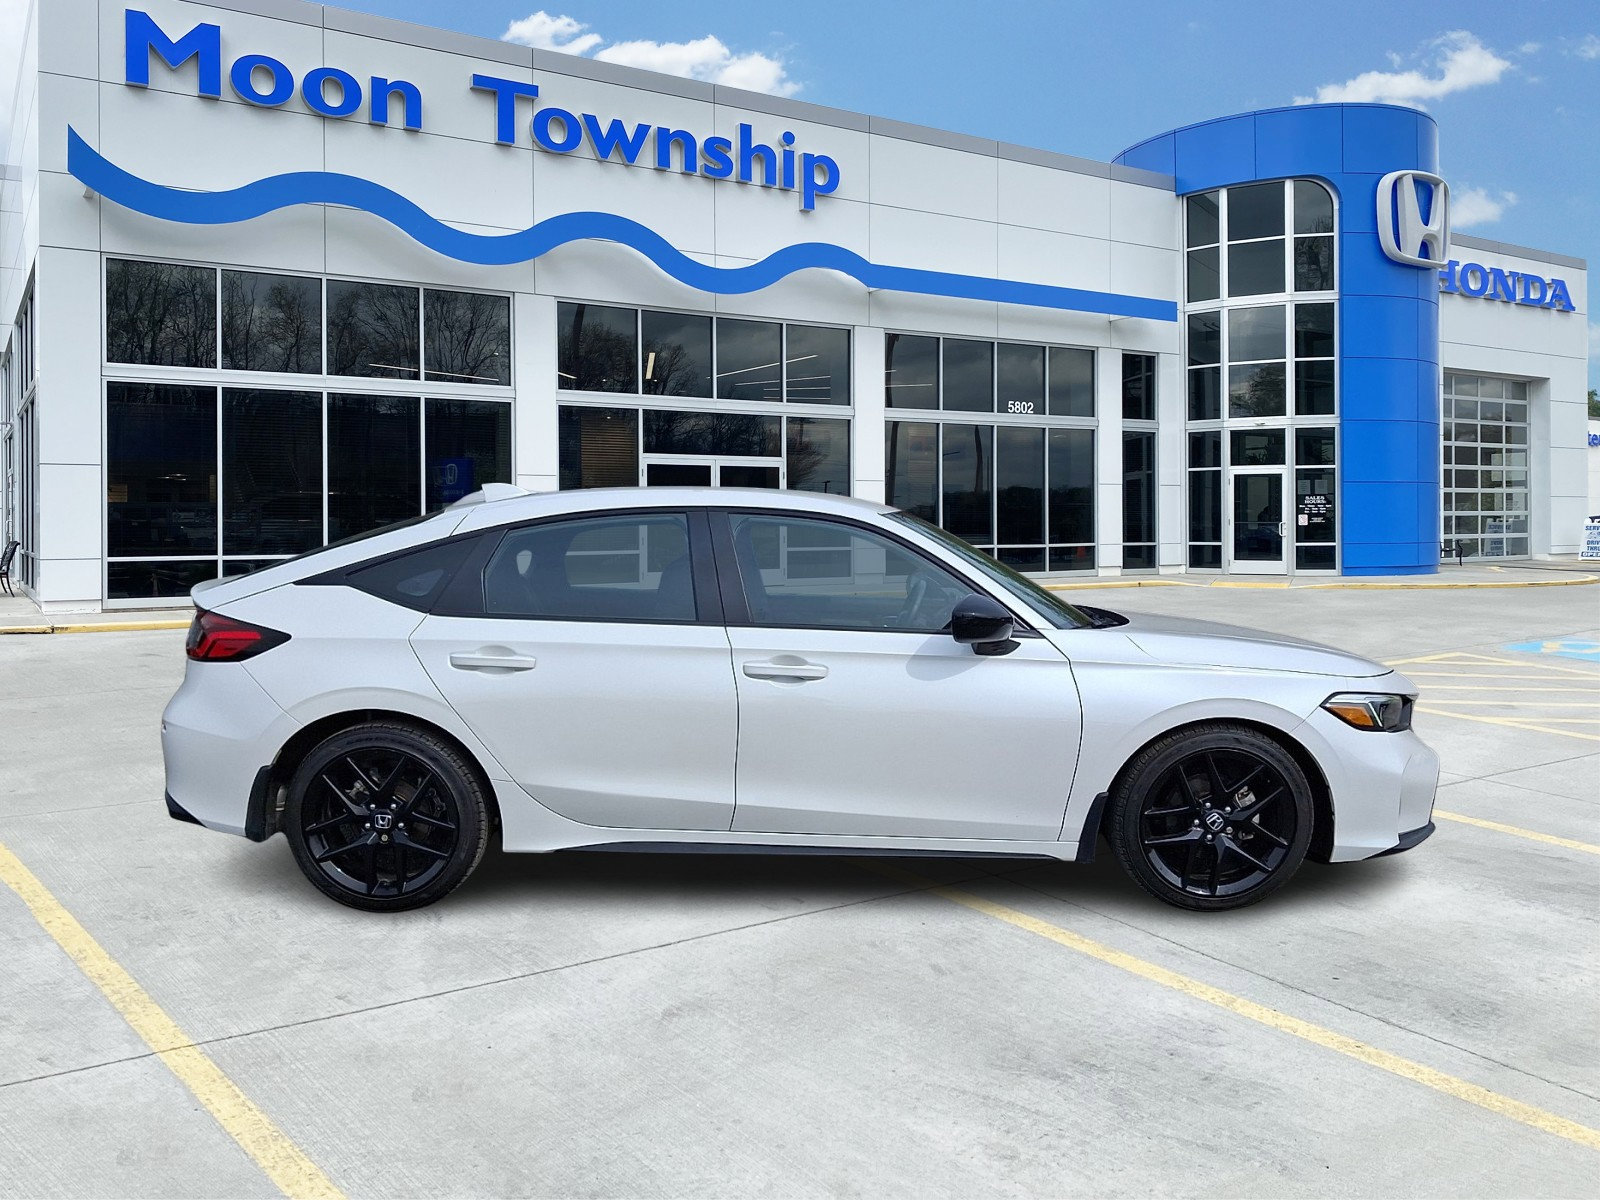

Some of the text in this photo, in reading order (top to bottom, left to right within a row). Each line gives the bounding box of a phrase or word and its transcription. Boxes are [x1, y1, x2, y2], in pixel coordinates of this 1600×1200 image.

[125, 9, 841, 211] Moon Township
[1008, 401, 1034, 414] 5802
